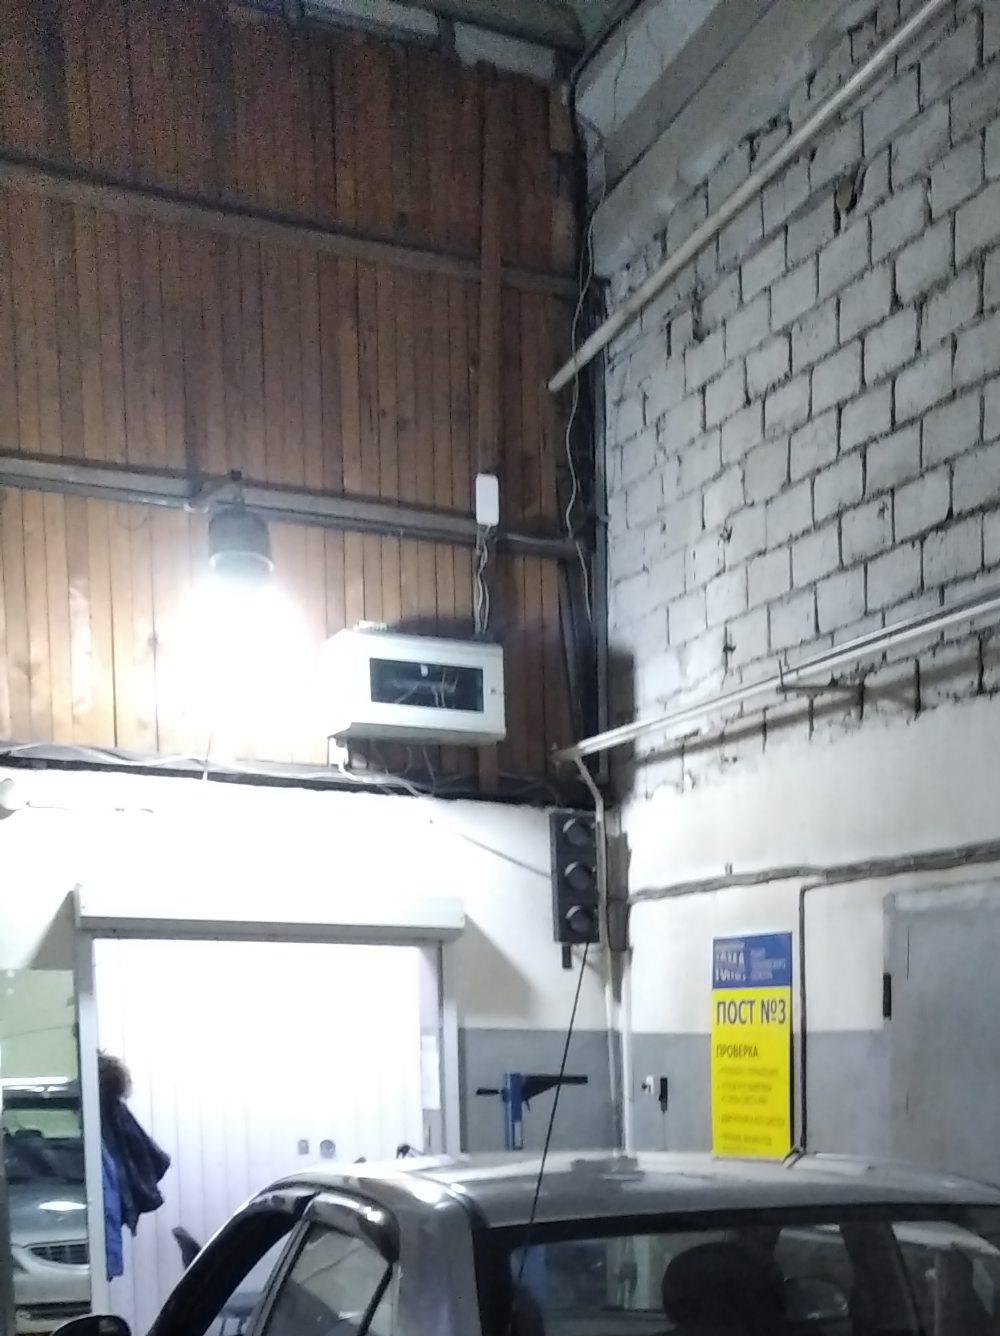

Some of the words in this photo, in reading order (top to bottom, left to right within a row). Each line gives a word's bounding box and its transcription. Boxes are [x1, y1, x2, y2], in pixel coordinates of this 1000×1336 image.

[717, 1000, 755, 1025] ПОСТ
[760, 998, 786, 1024] №3
[716, 1043, 759, 1059] ПРОВЕРКА
